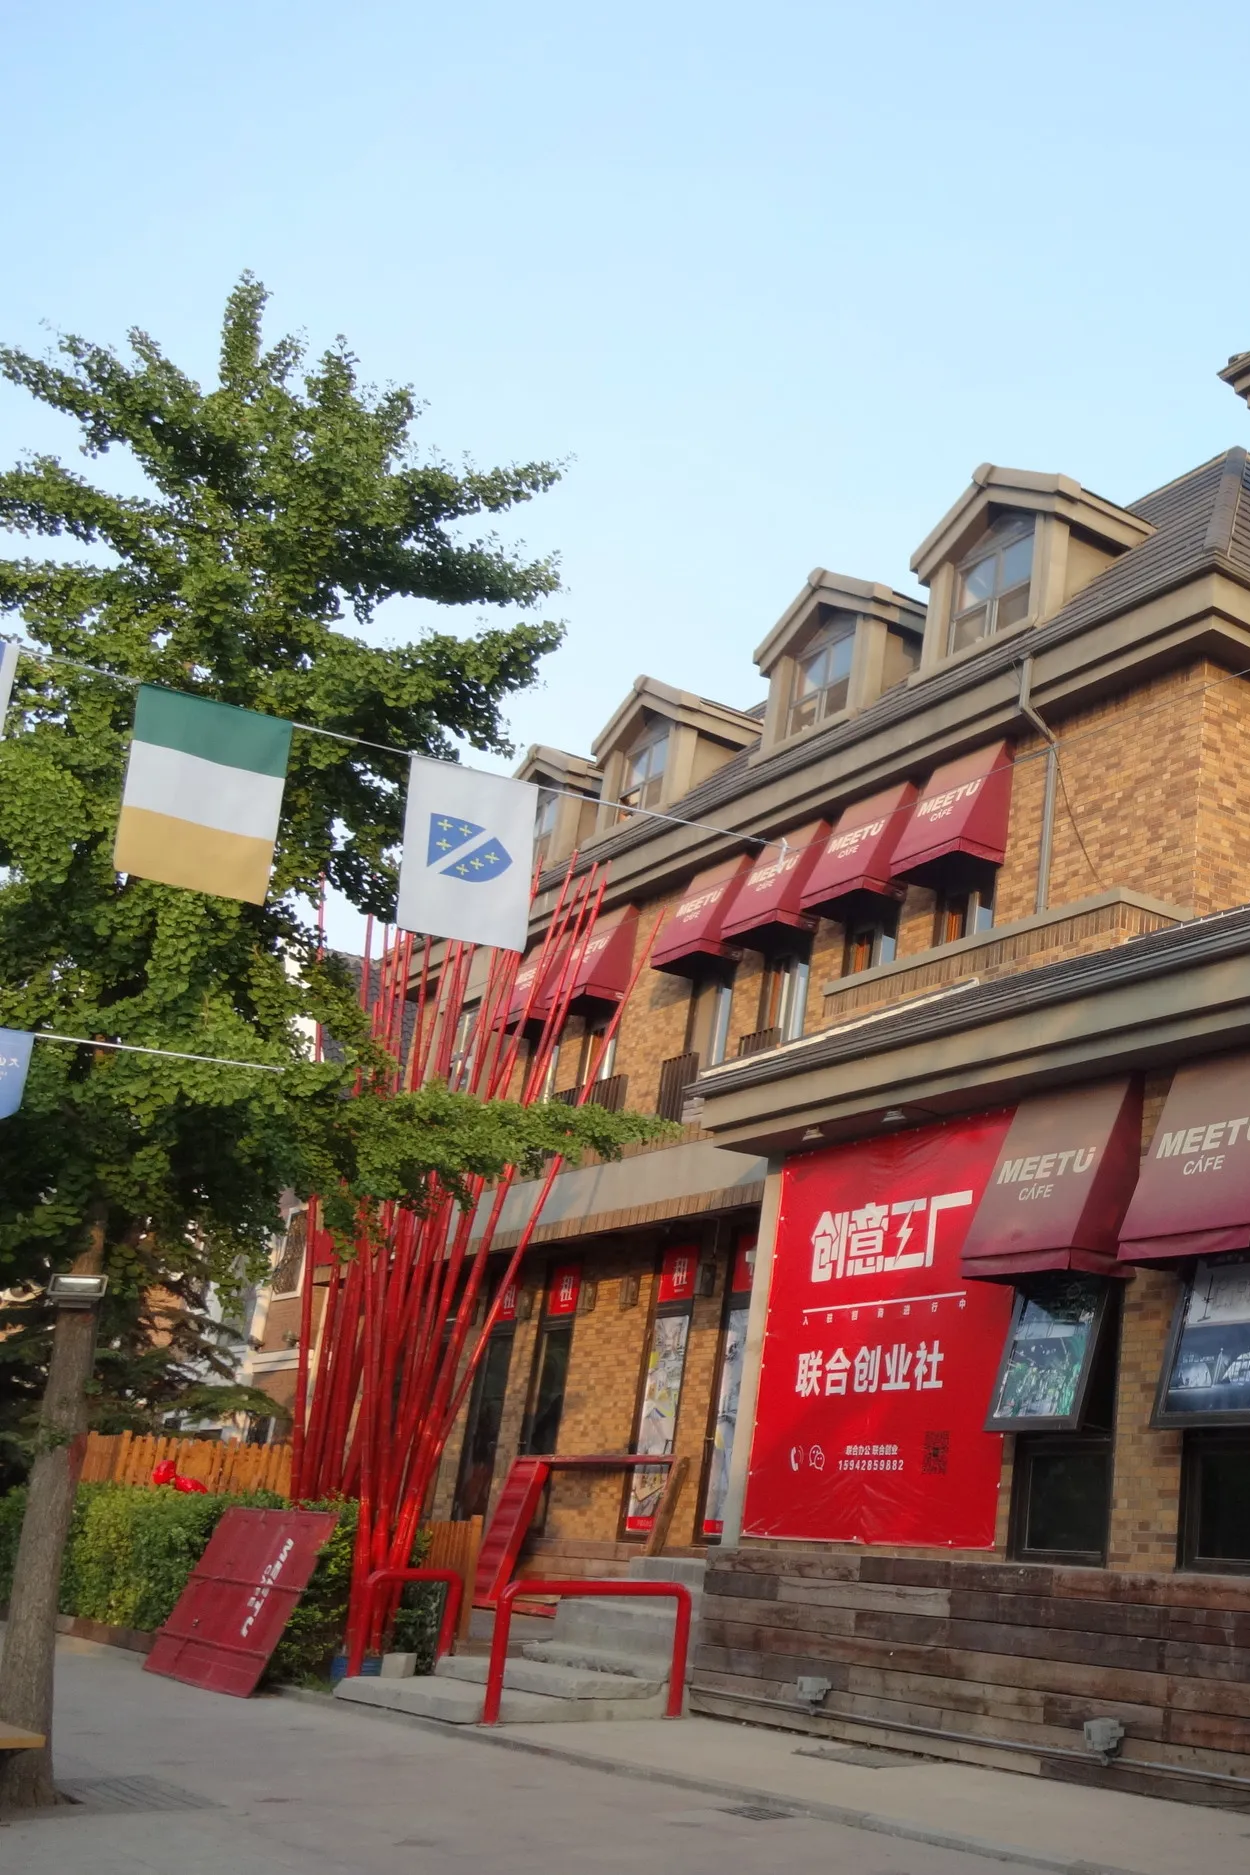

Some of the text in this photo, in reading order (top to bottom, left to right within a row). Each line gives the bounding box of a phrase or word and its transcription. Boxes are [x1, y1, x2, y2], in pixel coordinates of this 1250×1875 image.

[996, 1146, 1097, 1185] MEETU
[811, 1190, 974, 1283] 创意工厂
[671, 1257, 688, 1287] 租
[795, 1340, 945, 1398] 联合创业社
[838, 1459, 905, 1472] 15942859882
